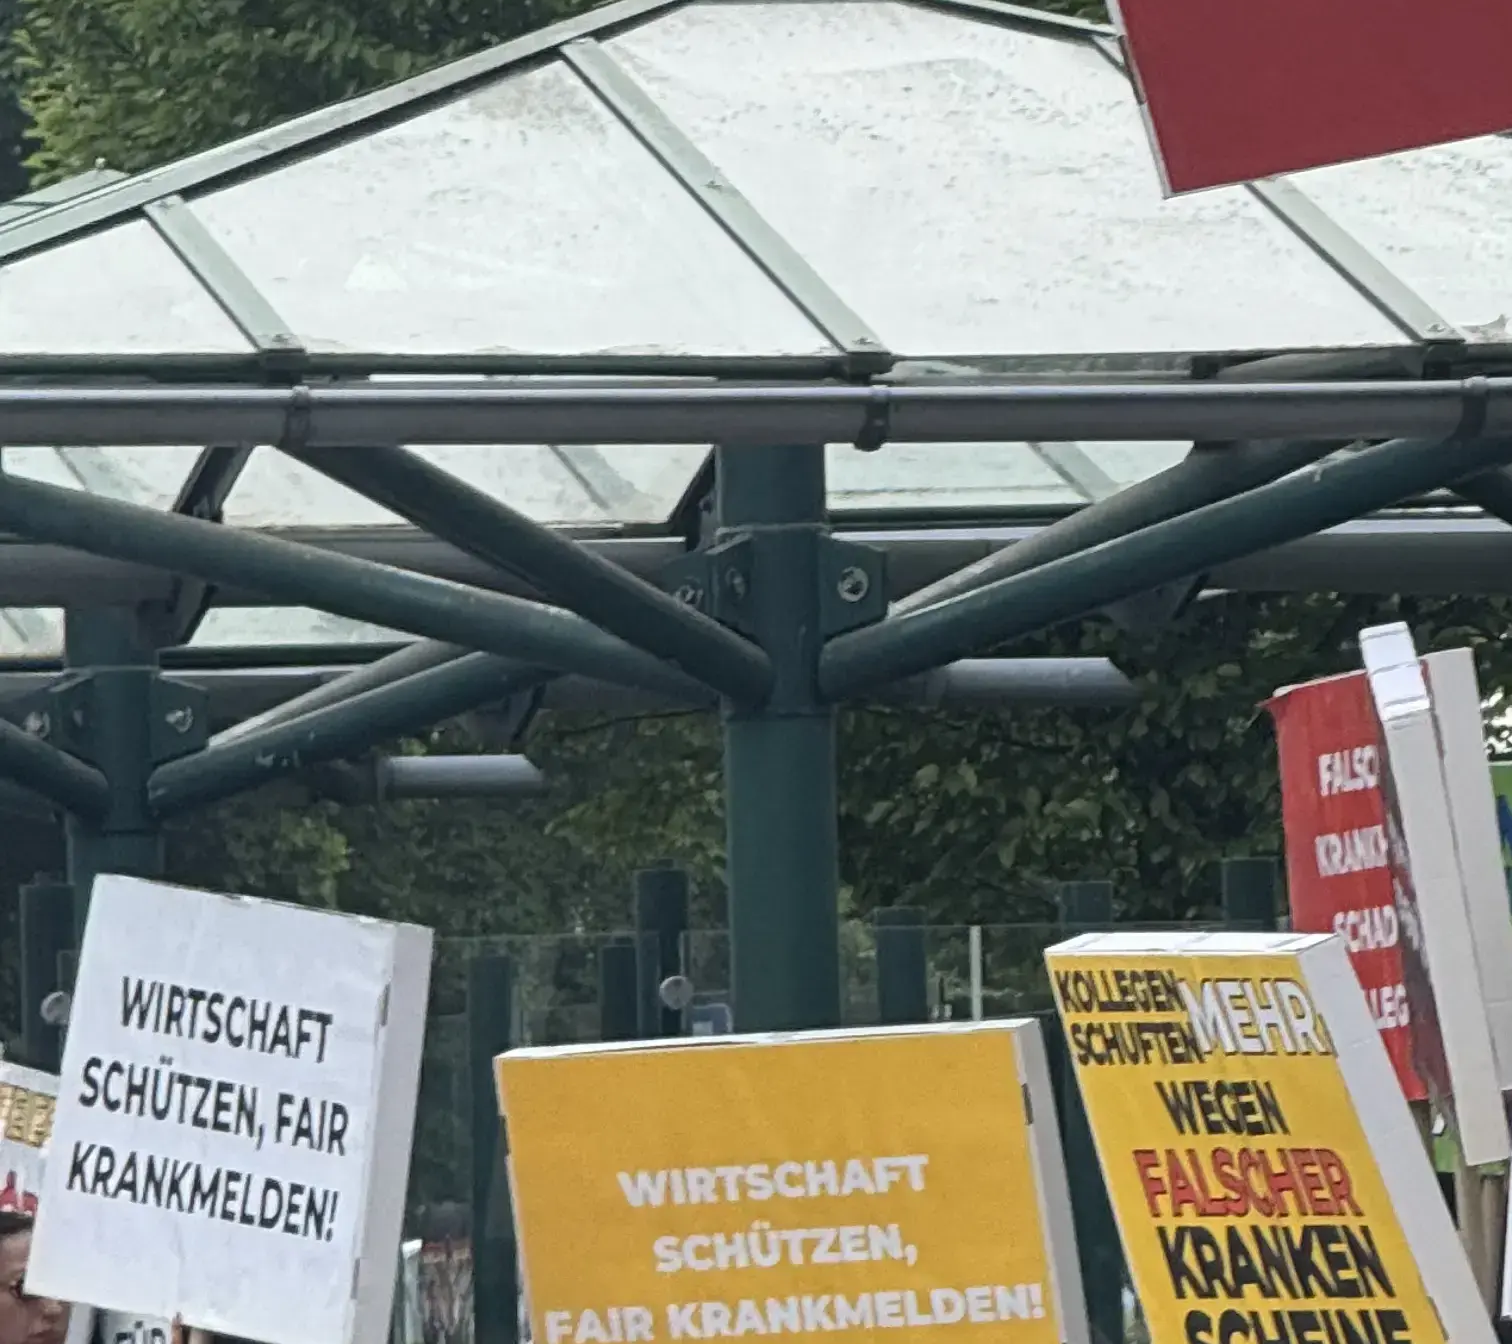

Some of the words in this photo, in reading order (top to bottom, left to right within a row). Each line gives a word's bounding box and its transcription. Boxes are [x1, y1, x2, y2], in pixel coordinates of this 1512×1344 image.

[120, 975, 333, 1063] WIRTSCHAFT
[1054, 969, 1189, 1014] KOLLEGEN
[1176, 977, 1338, 1056] MEHR
[1070, 1021, 1205, 1067] SCHUFTEN
[78, 1056, 265, 1151] SCHÜTZEN,
[275, 1093, 349, 1156] FAIR
[1153, 1079, 1291, 1137] WEGEN
[66, 1142, 339, 1243] KRANKMELDEN!
[616, 1154, 930, 1208] WIRTSCHAFT
[1132, 1147, 1365, 1218] FALSCHER
[652, 1220, 918, 1273] SCHÜTZEN,
[1155, 1224, 1397, 1300] KRANKEN
[666, 1282, 1046, 1339] KRANKMELDEN!
